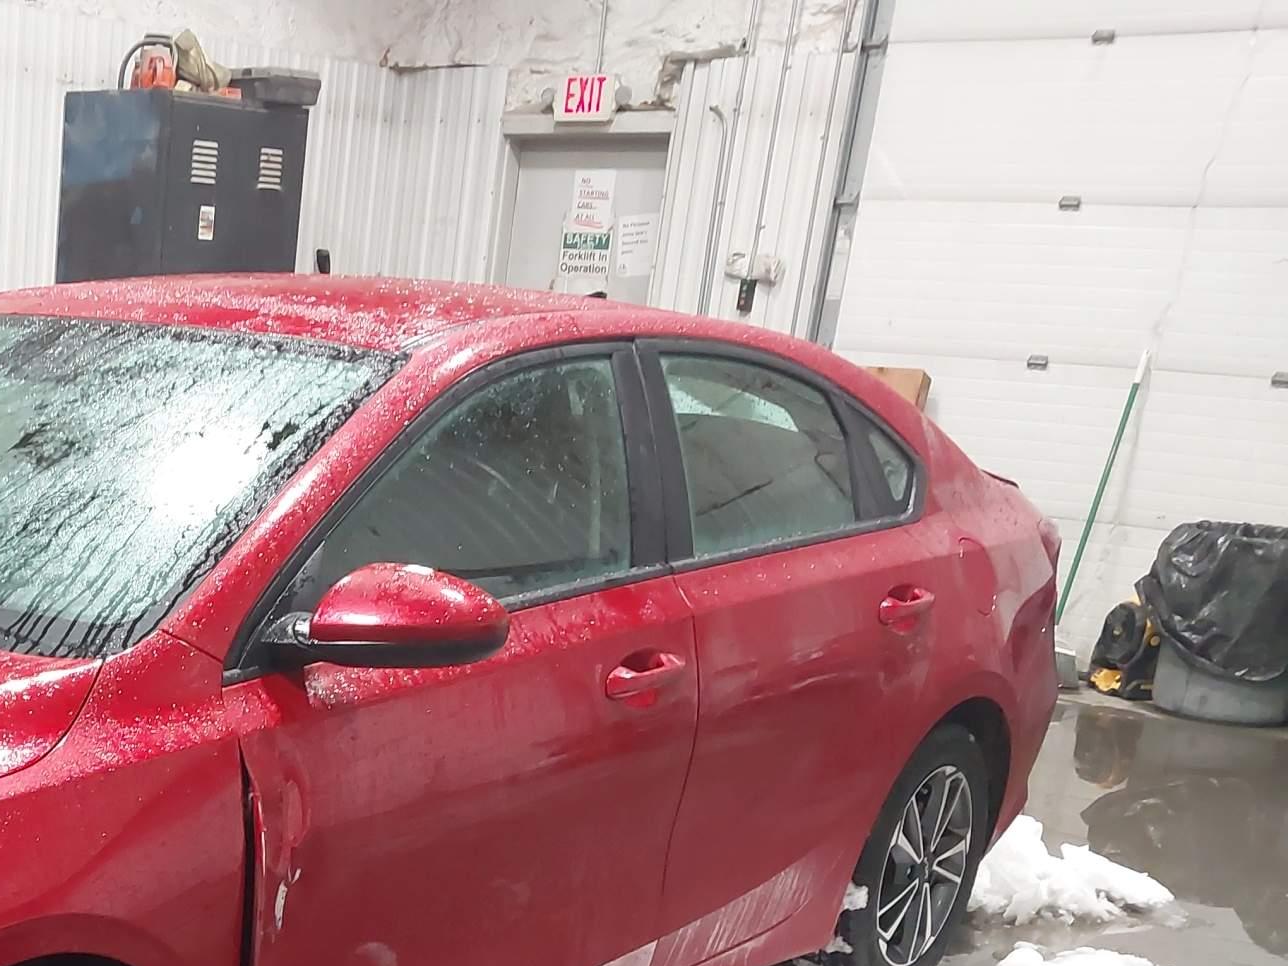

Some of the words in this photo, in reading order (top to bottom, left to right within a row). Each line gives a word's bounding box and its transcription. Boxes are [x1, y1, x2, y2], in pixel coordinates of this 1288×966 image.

[564, 77, 607, 113] EXIT
[566, 232, 609, 246] SAFETY
[562, 250, 596, 261] Forklift
[598, 251, 608, 262] In
[560, 262, 607, 275] Operation
